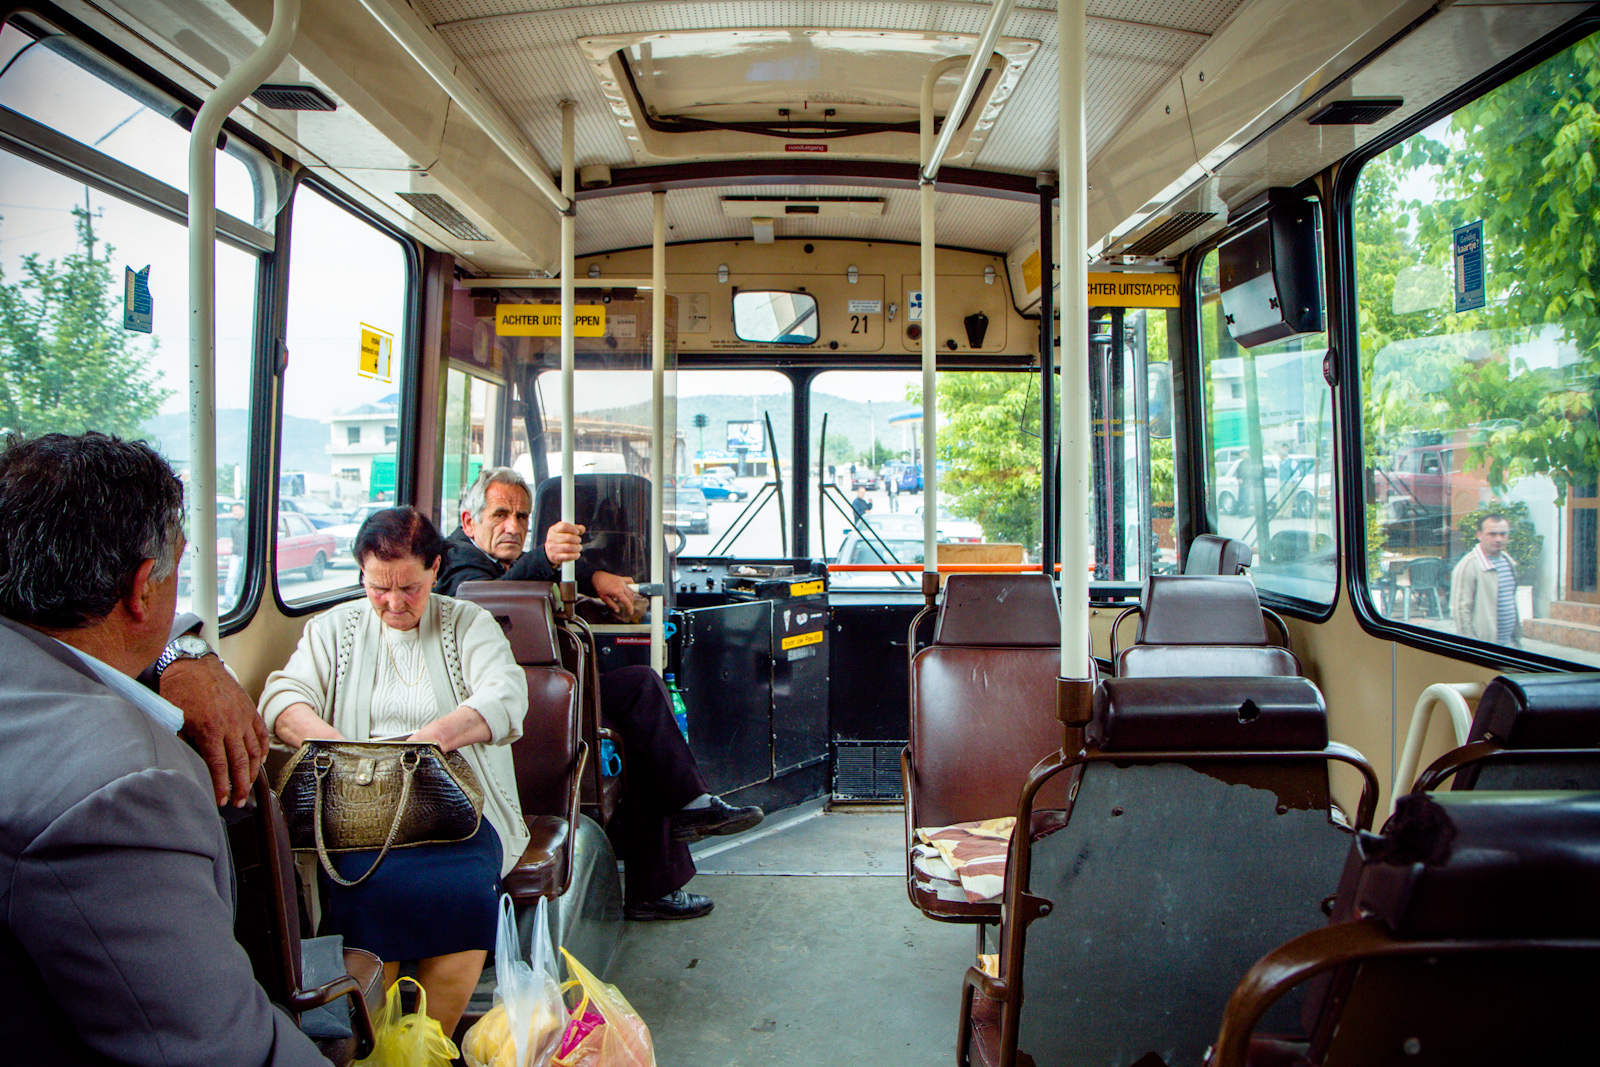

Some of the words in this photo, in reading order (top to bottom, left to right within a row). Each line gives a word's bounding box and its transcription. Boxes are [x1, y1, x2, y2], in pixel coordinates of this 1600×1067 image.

[1460, 232, 1477, 244] Geldig
[1457, 239, 1480, 254] kaartje?
[1119, 283, 1180, 296] UITSTAPPEN
[502, 315, 539, 326] ACHTER
[543, 315, 600, 326] UITSPPEN
[850, 315, 868, 334] 21
